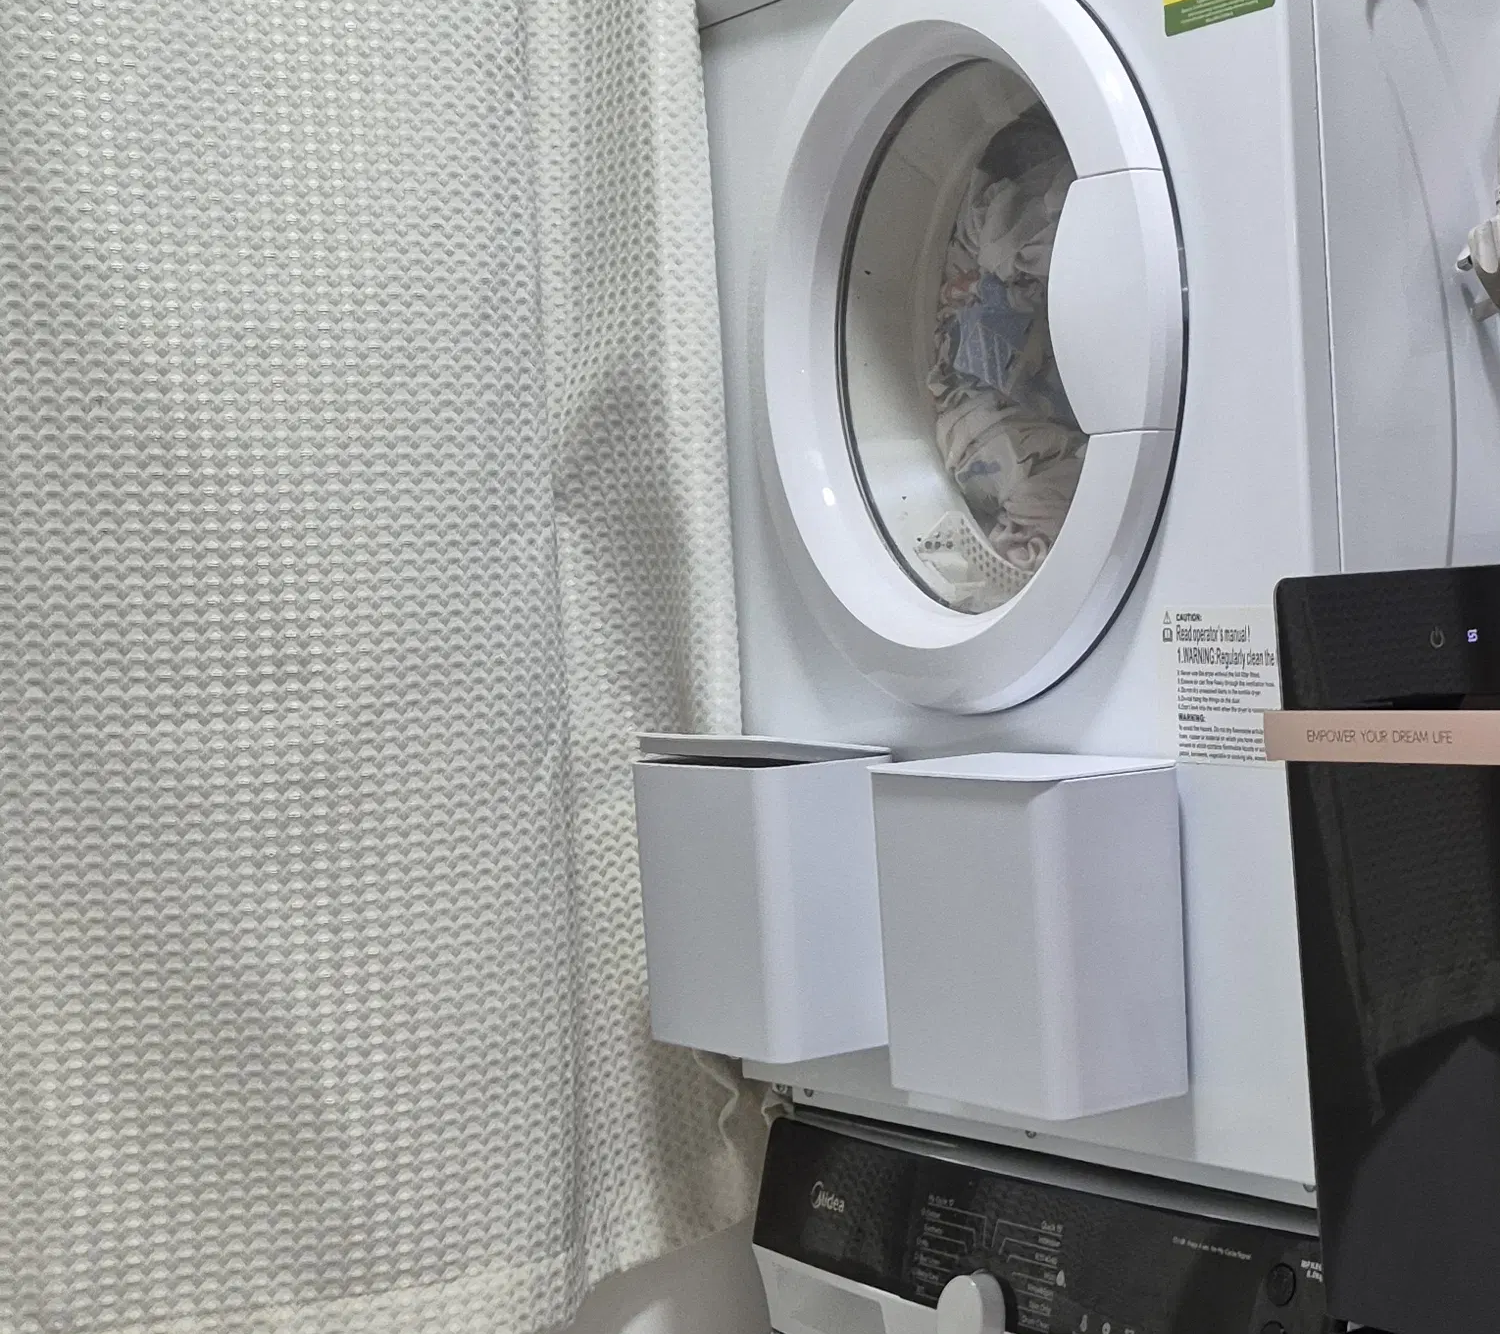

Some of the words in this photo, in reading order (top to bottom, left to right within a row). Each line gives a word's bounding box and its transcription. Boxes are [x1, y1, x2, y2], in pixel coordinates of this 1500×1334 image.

[1176, 613, 1202, 621] CAUTION:
[1176, 625, 1192, 642] Read
[1193, 626, 1223, 645] operator's
[1246, 648, 1264, 666] clean
[1264, 649, 1275, 666] the
[1306, 729, 1356, 743] EMPOWER
[1360, 729, 1388, 743] YOUR
[1392, 730, 1428, 744] DREAM
[1432, 731, 1453, 744] LIFE
[811, 1181, 845, 1213] Midea
